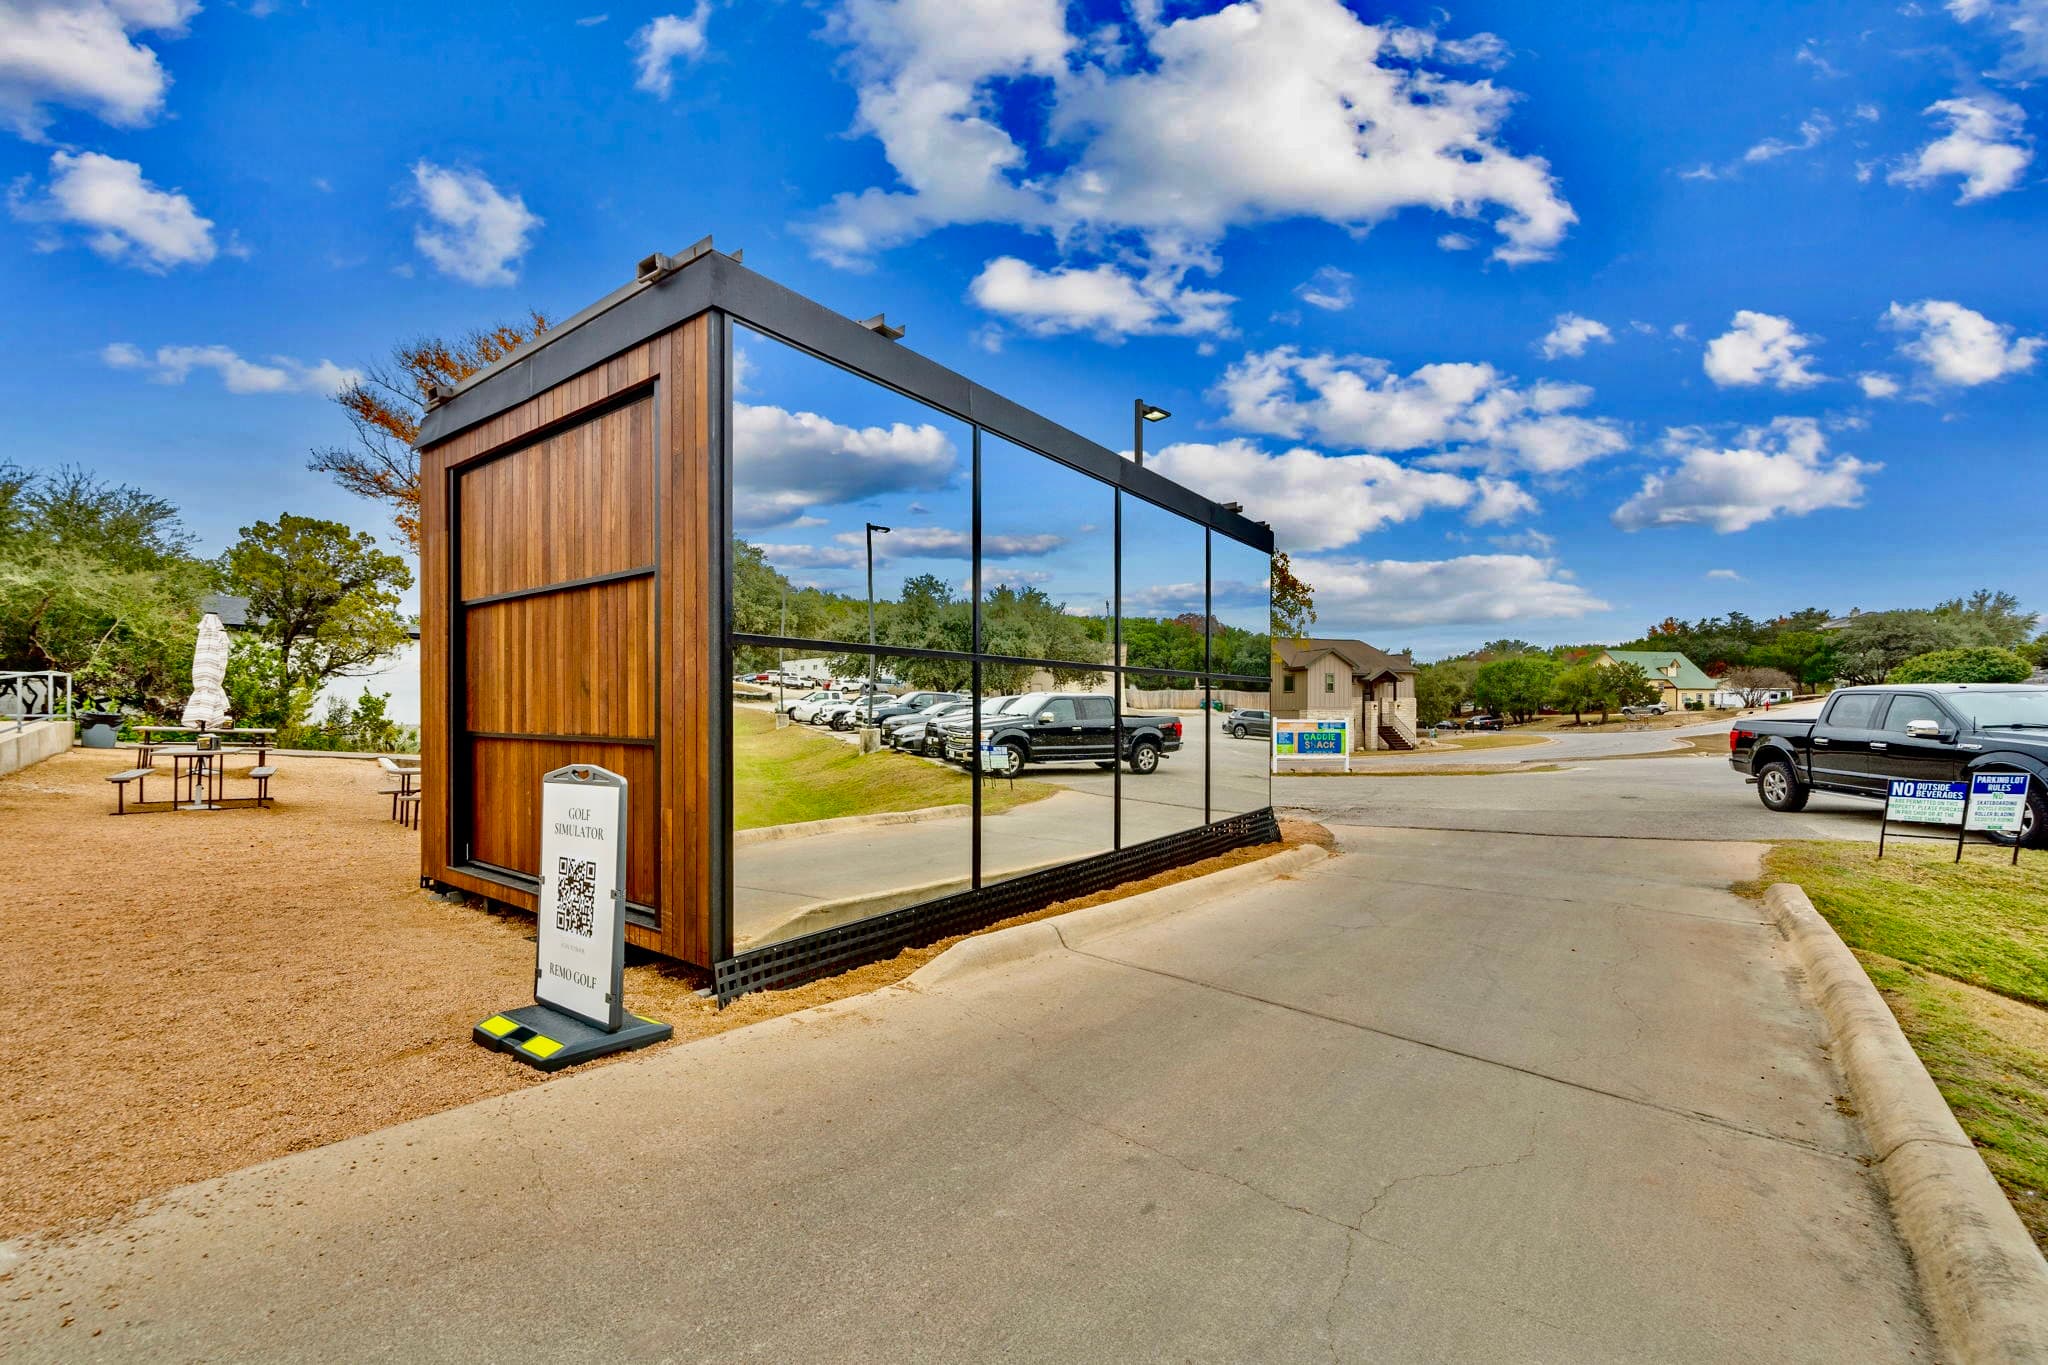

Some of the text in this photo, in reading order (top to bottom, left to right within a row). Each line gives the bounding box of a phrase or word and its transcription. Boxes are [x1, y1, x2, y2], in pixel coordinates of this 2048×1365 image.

[1916, 782, 1951, 791] OUTSIDE
[1977, 776, 2010, 784] PARKING
[1892, 781, 1915, 796] NO
[1915, 790, 1964, 799] BEVERAGES
[568, 807, 591, 821] GOLF
[554, 822, 604, 841] SIMULATOR
[549, 962, 597, 989] REMO GOLF
